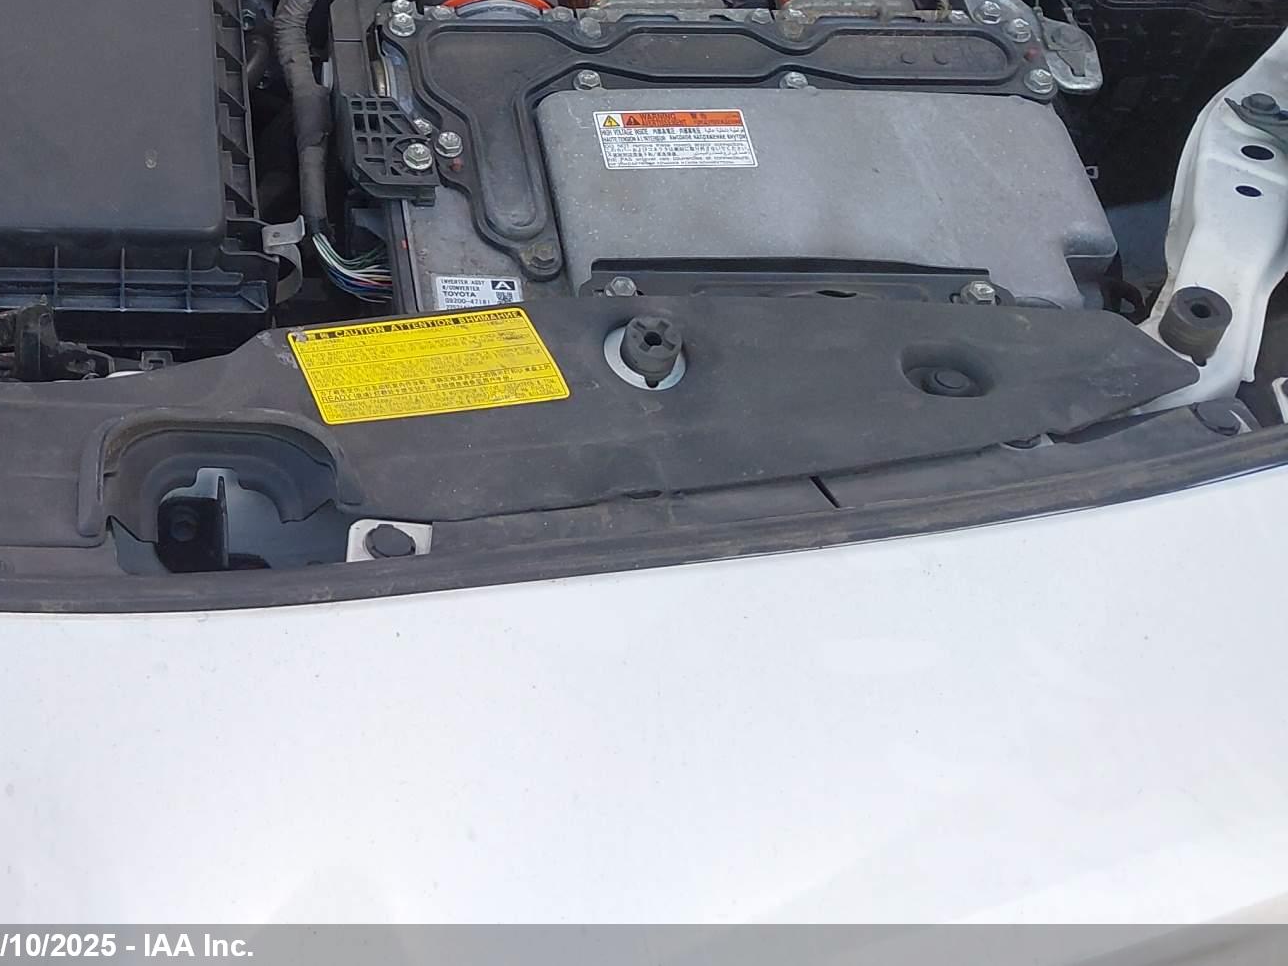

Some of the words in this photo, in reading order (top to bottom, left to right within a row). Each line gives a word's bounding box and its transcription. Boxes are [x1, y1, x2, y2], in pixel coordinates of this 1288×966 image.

[390, 318, 454, 332] ATTENTION
[458, 311, 521, 325] ВНИМАНИЕ
[335, 325, 386, 338] CAUTION
